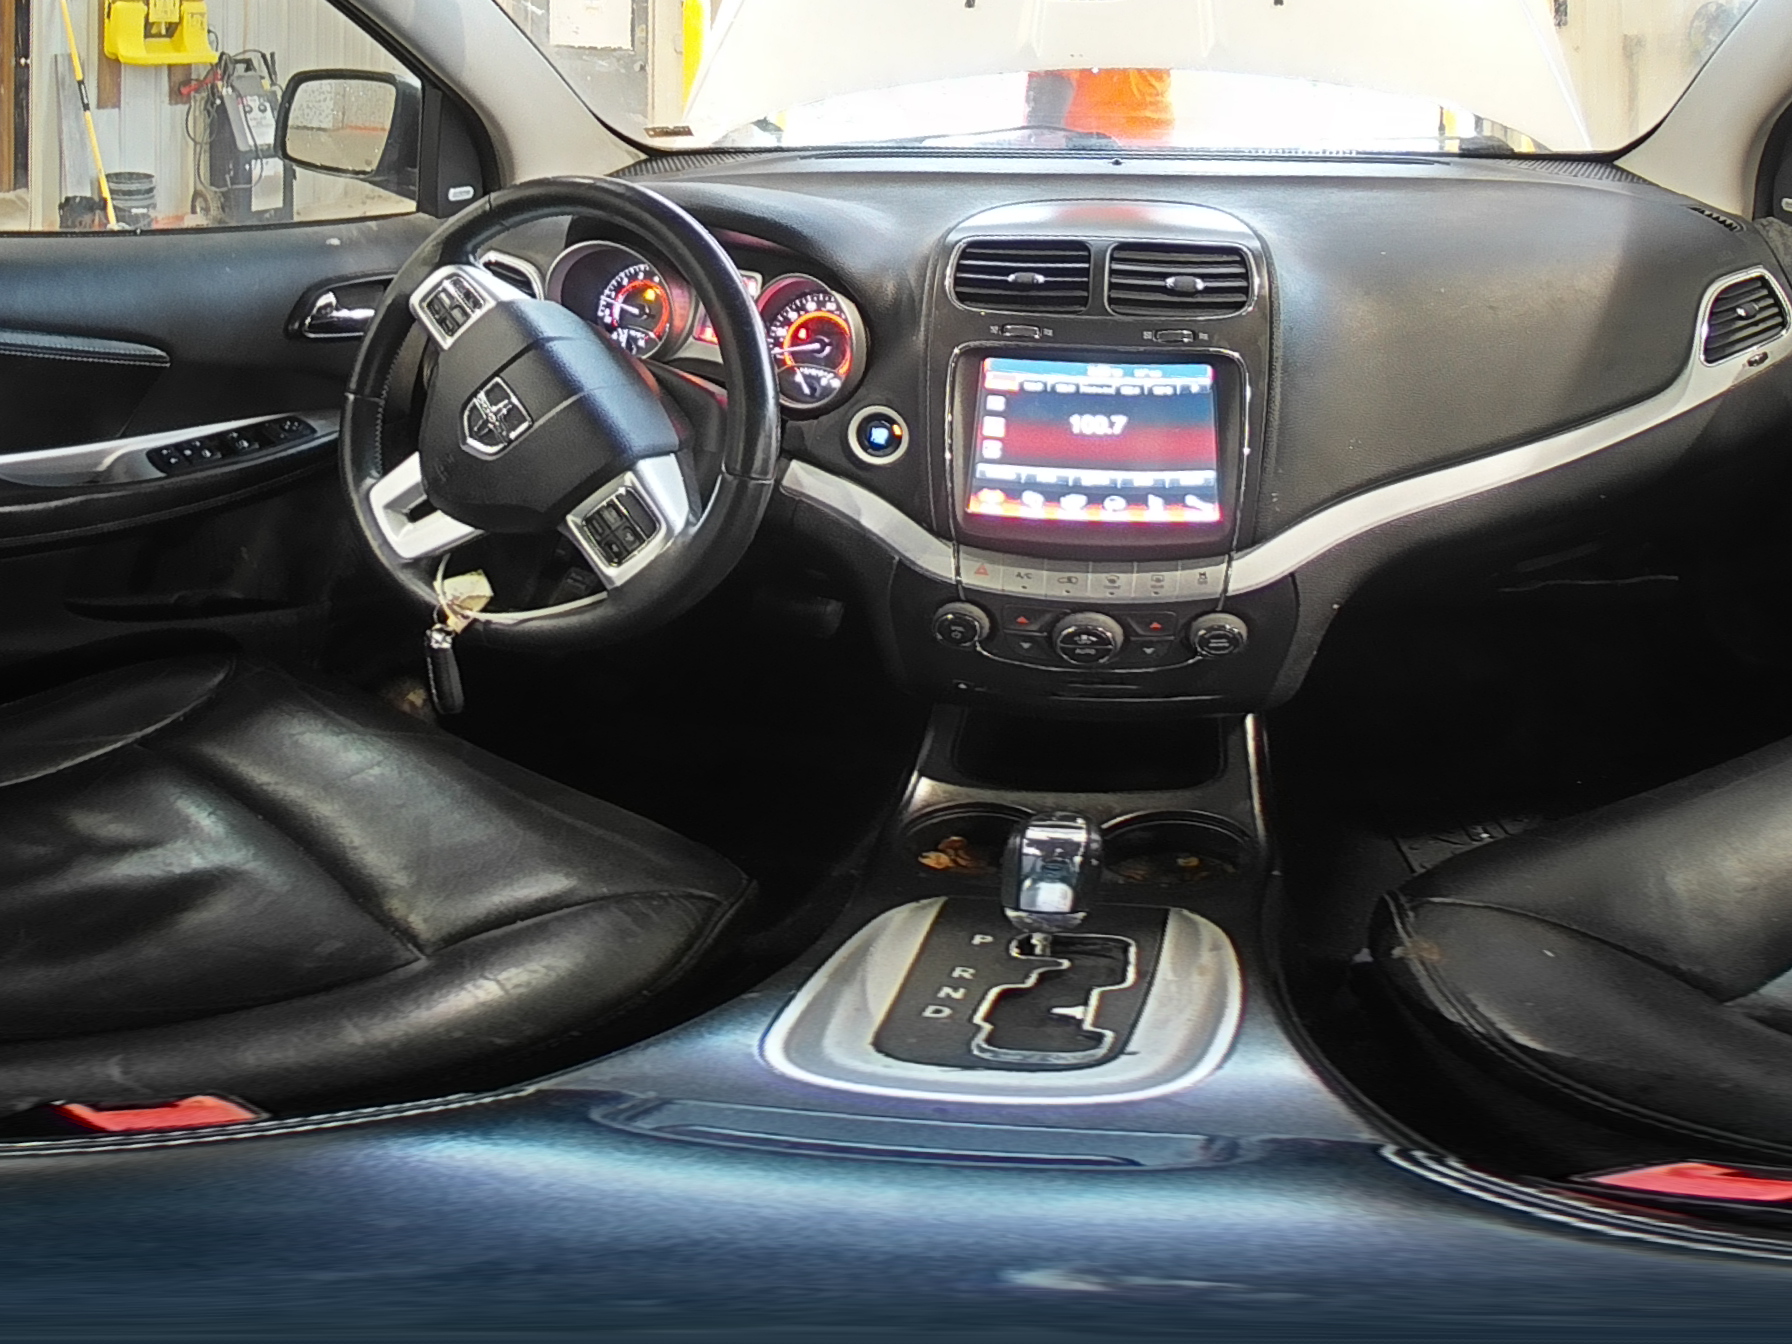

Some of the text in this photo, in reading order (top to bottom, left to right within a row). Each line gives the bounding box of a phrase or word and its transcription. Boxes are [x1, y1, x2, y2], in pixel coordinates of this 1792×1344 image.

[1069, 414, 1128, 435] 100.7
[971, 934, 994, 945] P
[951, 966, 976, 979] R
[937, 986, 966, 999] N
[921, 1005, 953, 1017] D
